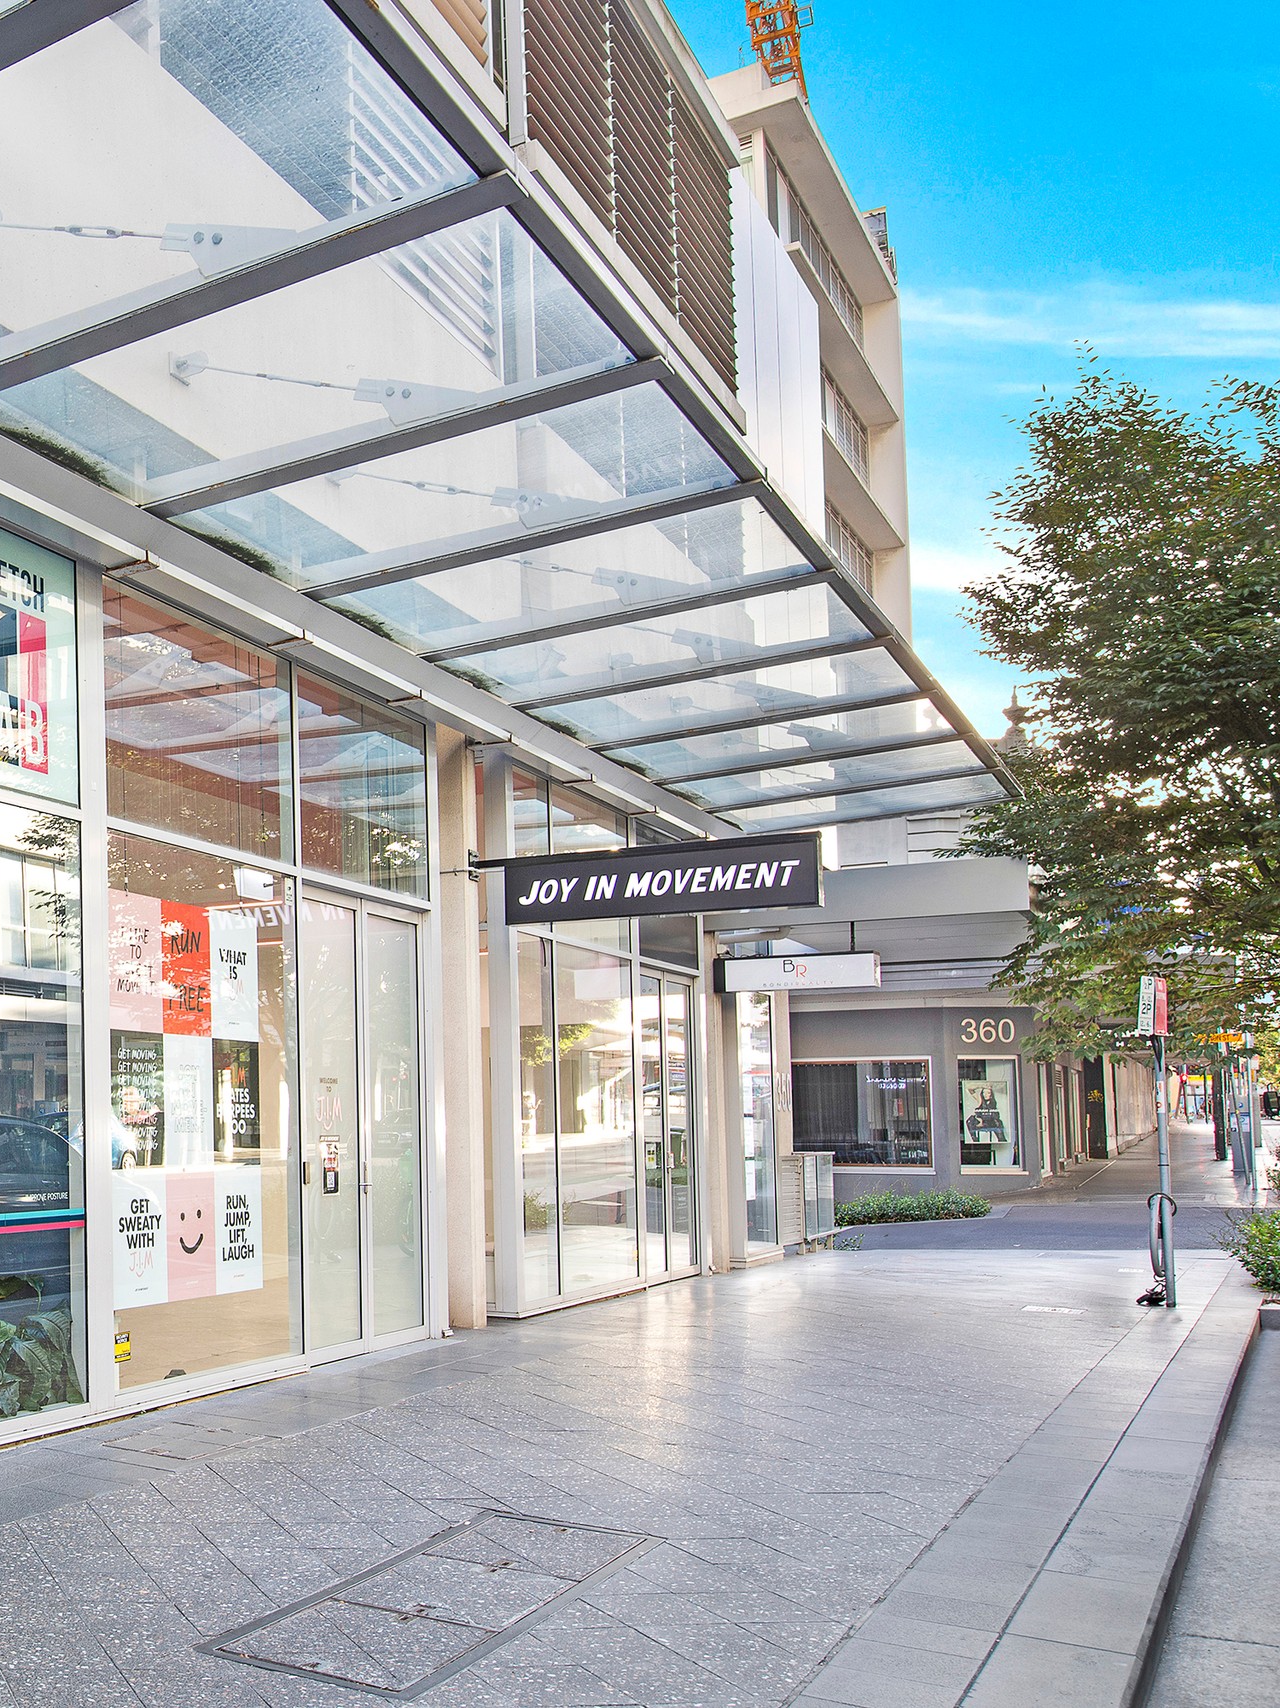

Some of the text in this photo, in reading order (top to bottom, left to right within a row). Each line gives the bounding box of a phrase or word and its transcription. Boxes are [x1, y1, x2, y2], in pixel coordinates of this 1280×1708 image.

[519, 859, 801, 906] JOY IN MOVEMENT
[171, 929, 202, 954] RUN
[129, 944, 143, 960] TO
[219, 948, 247, 966] WHAT
[229, 966, 238, 980] IS
[783, 959, 807, 978] BR
[961, 1018, 1015, 1043] 360
[118, 1048, 157, 1060] GET MOVING
[118, 1060, 157, 1073] GET MOVING
[137, 1088, 157, 1099] OVING
[216, 1103, 257, 1120] BRPEES
[231, 1118, 247, 1135] OO
[138, 1140, 159, 1150] OVING
[47, 1191, 69, 1201] POSTURE
[226, 1195, 249, 1211] RUN,
[130, 1199, 150, 1214] GET
[118, 1214, 162, 1233] SWEATY
[224, 1211, 252, 1228] JUMP,
[126, 1232, 155, 1249] WITH
[228, 1228, 248, 1244] LIFT,
[222, 1244, 255, 1262] LAUGH
